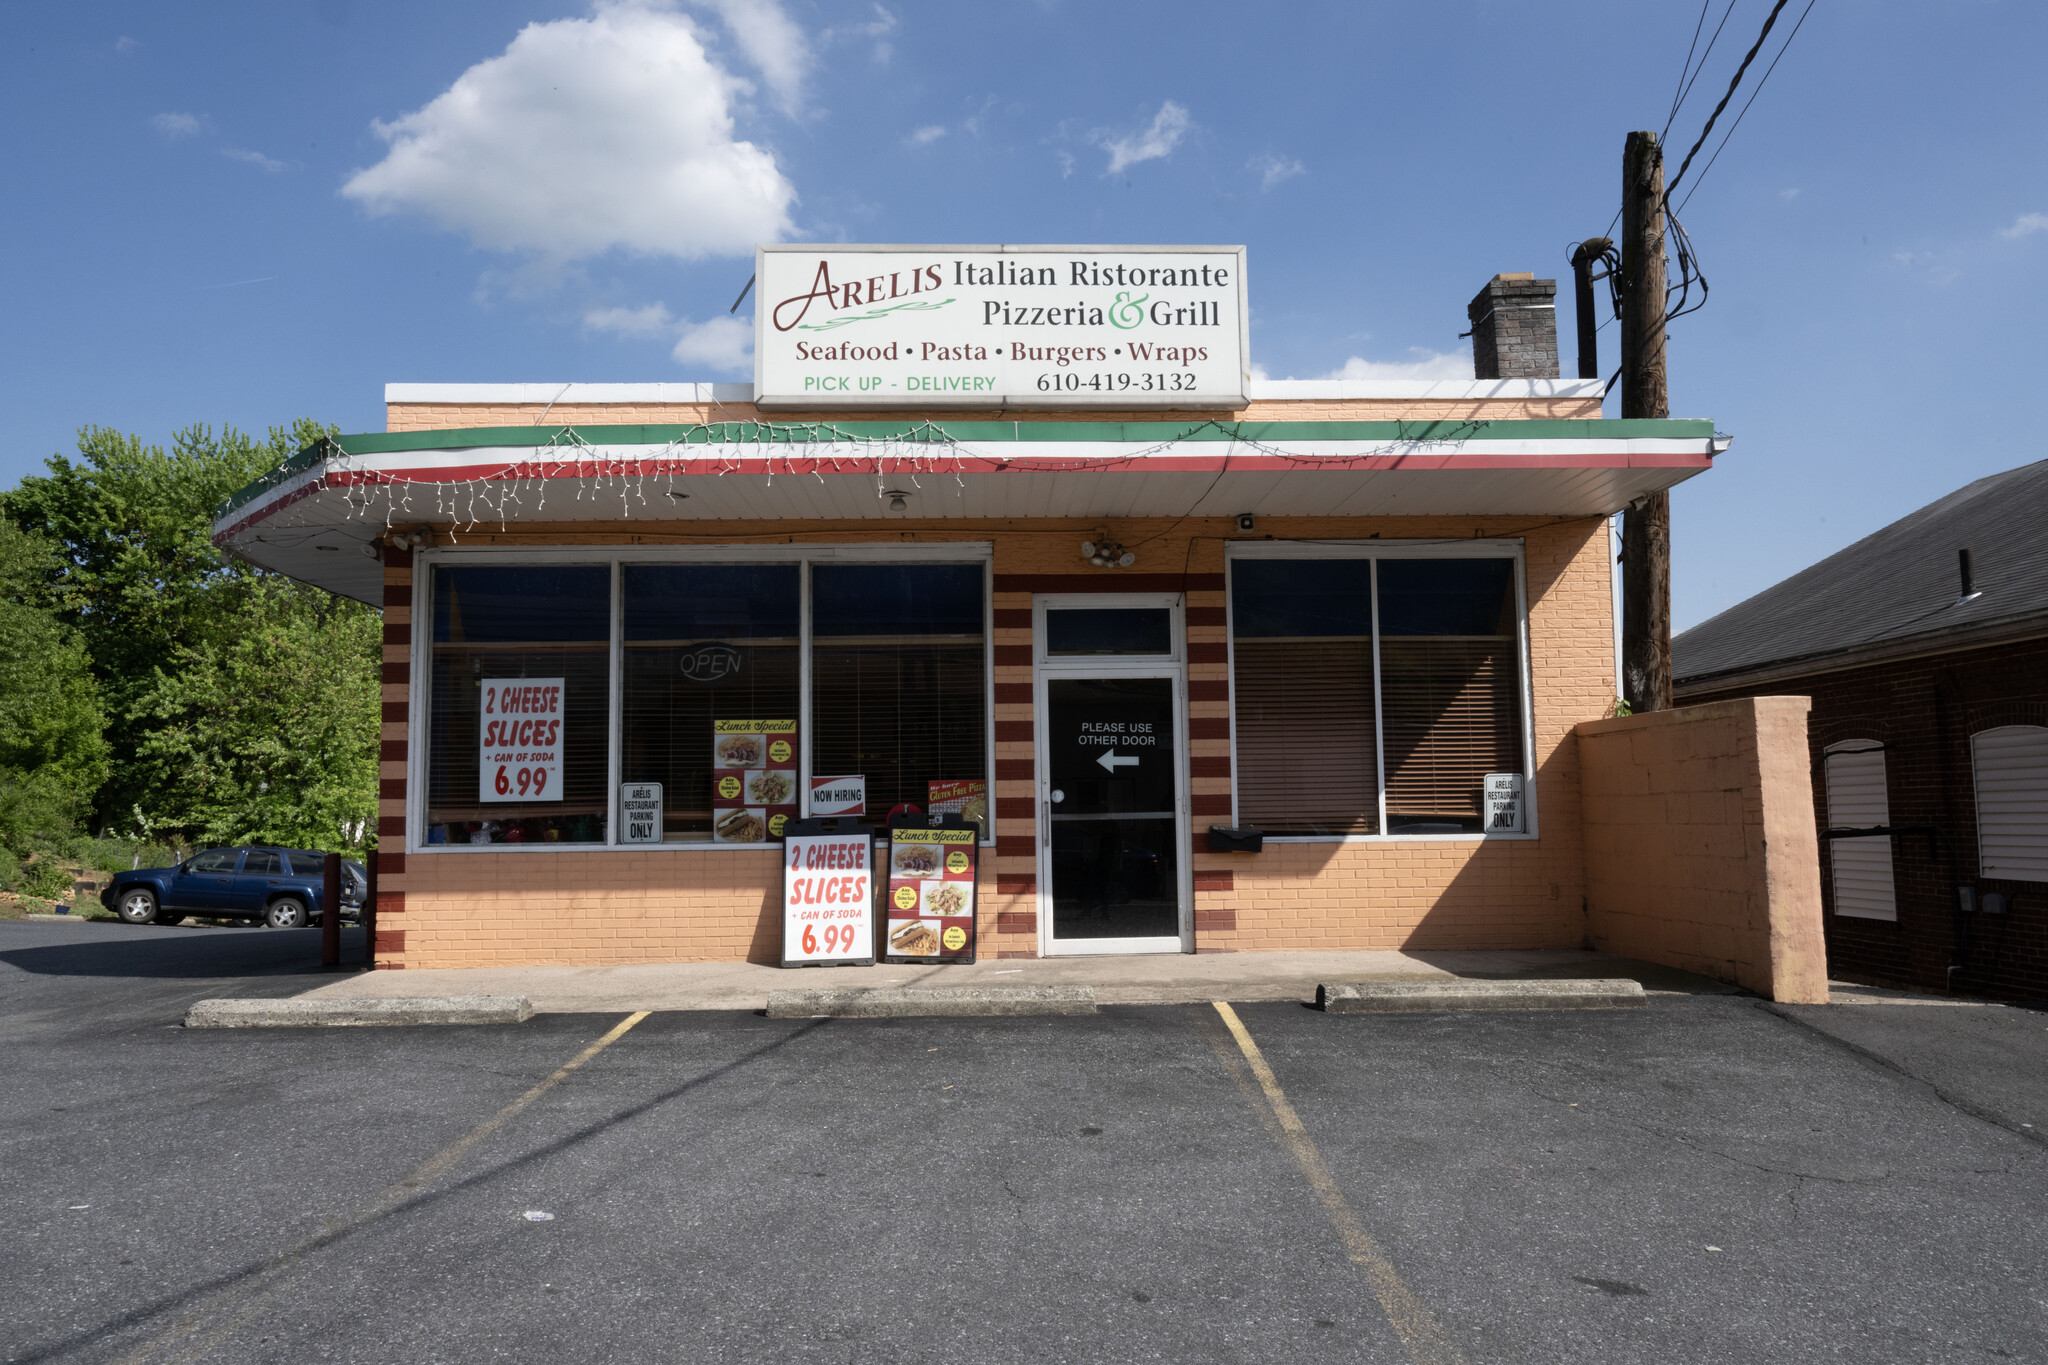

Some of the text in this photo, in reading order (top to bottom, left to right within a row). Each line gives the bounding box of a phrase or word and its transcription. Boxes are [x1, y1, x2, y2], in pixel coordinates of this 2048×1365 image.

[773, 261, 1229, 331] ARELIS Italian Ristorante
[983, 291, 1220, 329] Pizzeria & Grill
[796, 341, 1209, 366] Seafood Pasta Burgers Wraps
[804, 376, 850, 391] PICK
[858, 376, 883, 391] UP
[906, 376, 996, 391] DELIVERY
[1036, 372, 1197, 392] 610-419-3132
[681, 654, 742, 673] OPEN
[486, 686, 560, 714] 2 CHEESE
[484, 720, 560, 747] SLICES
[716, 720, 795, 733] Lunch Special
[1082, 723, 1153, 733] PLEASE USE
[1078, 735, 1156, 746] OTHER DOOR
[494, 753, 513, 762] CAN
[516, 753, 528, 762] OF
[530, 753, 555, 762] SODA
[495, 765, 547, 797] 6.99
[1495, 781, 1513, 789] ARELIS
[632, 789, 651, 799] ARELIS
[814, 789, 862, 802] NOW HIRING
[1488, 791, 1520, 800] RESTAURANT
[624, 801, 659, 810] RESTAURANT
[1493, 802, 1515, 810] PARKING
[630, 811, 653, 821] PARKING
[1493, 812, 1515, 828] ONLY
[630, 822, 653, 838] ONLY
[893, 829, 973, 843] Lunch Special
[791, 843, 865, 871] 2 CHEESE
[790, 876, 867, 905] SLICES
[801, 911, 820, 920] CAN
[822, 910, 835, 919] OF
[837, 909, 862, 919] SODA
[802, 924, 855, 954] 6.99
